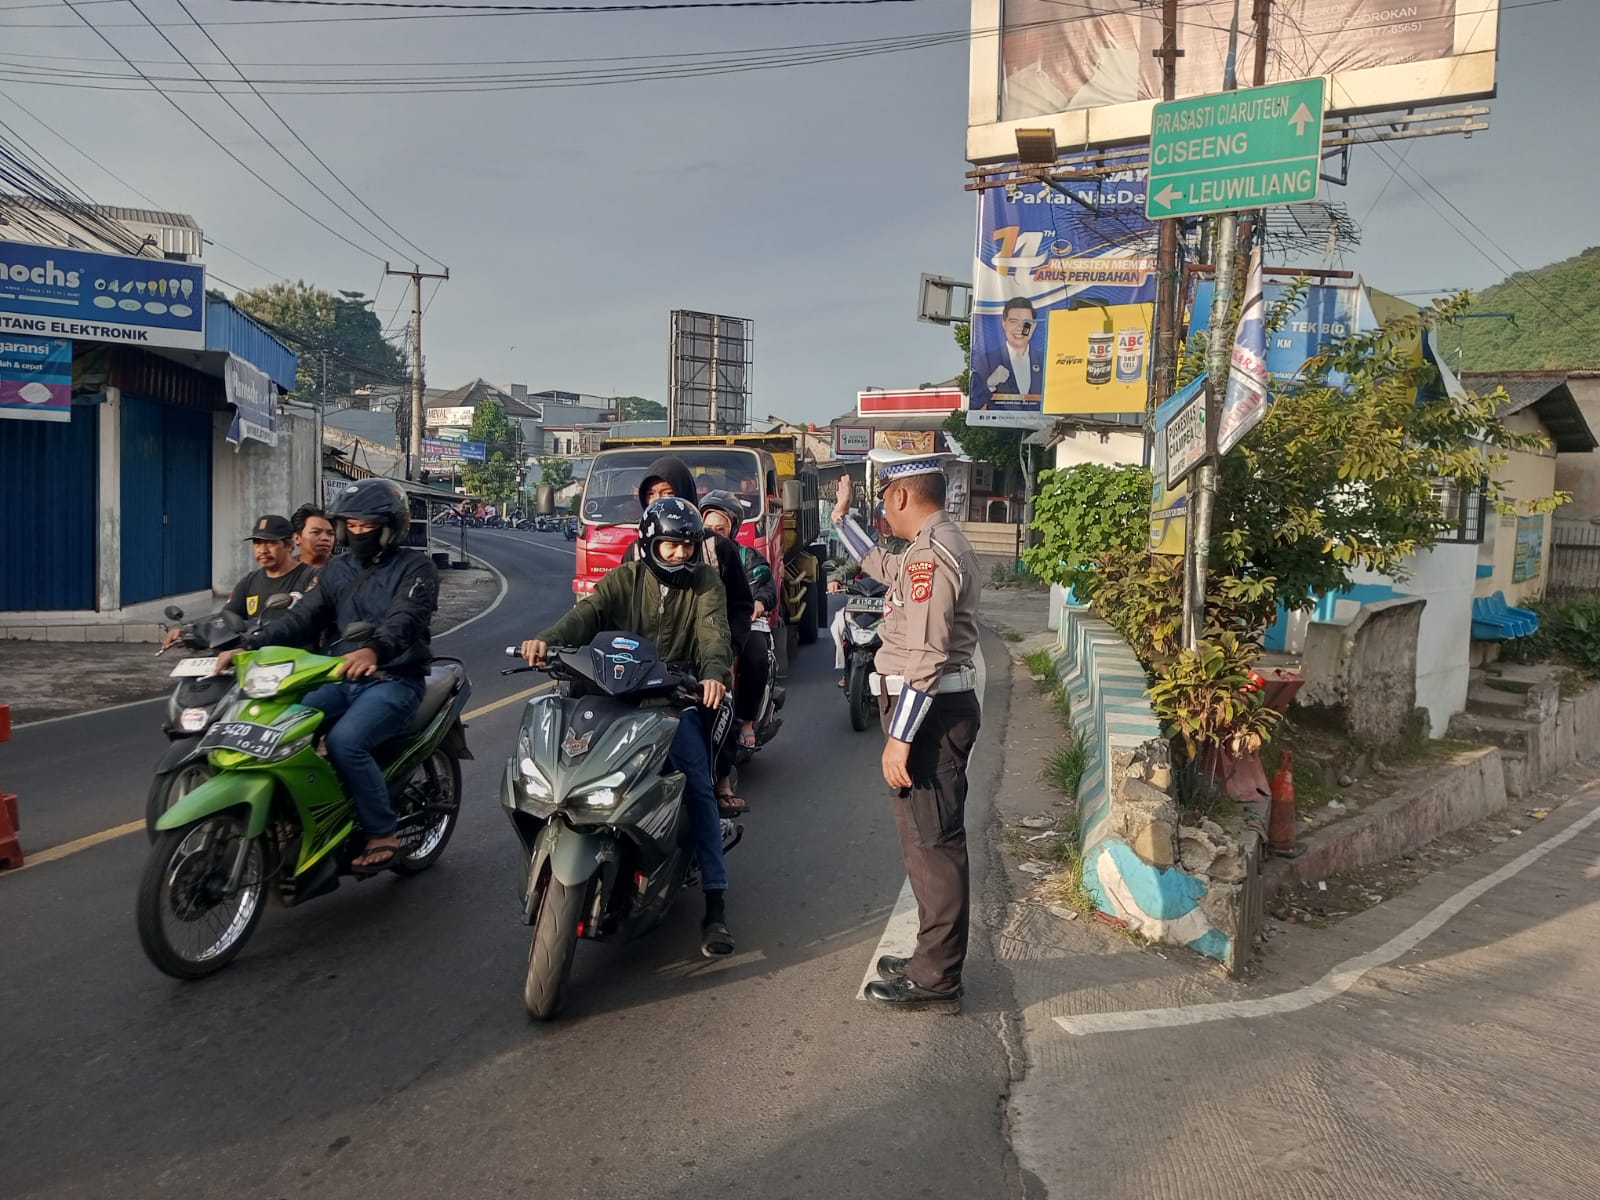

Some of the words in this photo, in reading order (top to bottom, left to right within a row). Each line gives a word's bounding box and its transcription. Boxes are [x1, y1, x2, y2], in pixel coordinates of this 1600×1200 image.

[1155, 106, 1215, 136] PRASASTI
[1217, 95, 1290, 126] CIARUTEUN
[1153, 131, 1249, 166] CISEENG
[1188, 169, 1312, 205] LEUWILIANG
[1037, 270, 1067, 281] ARUS
[1068, 271, 1139, 282] PERUBAHAN
[51, 321, 148, 341] ELEKTRONIK
[1119, 335, 1144, 347] ABC
[1276, 338, 1293, 349] KM
[1089, 344, 1112, 355] ABC
[1056, 358, 1083, 366] POWER
[1168, 404, 1197, 441] PUSKESMAS
